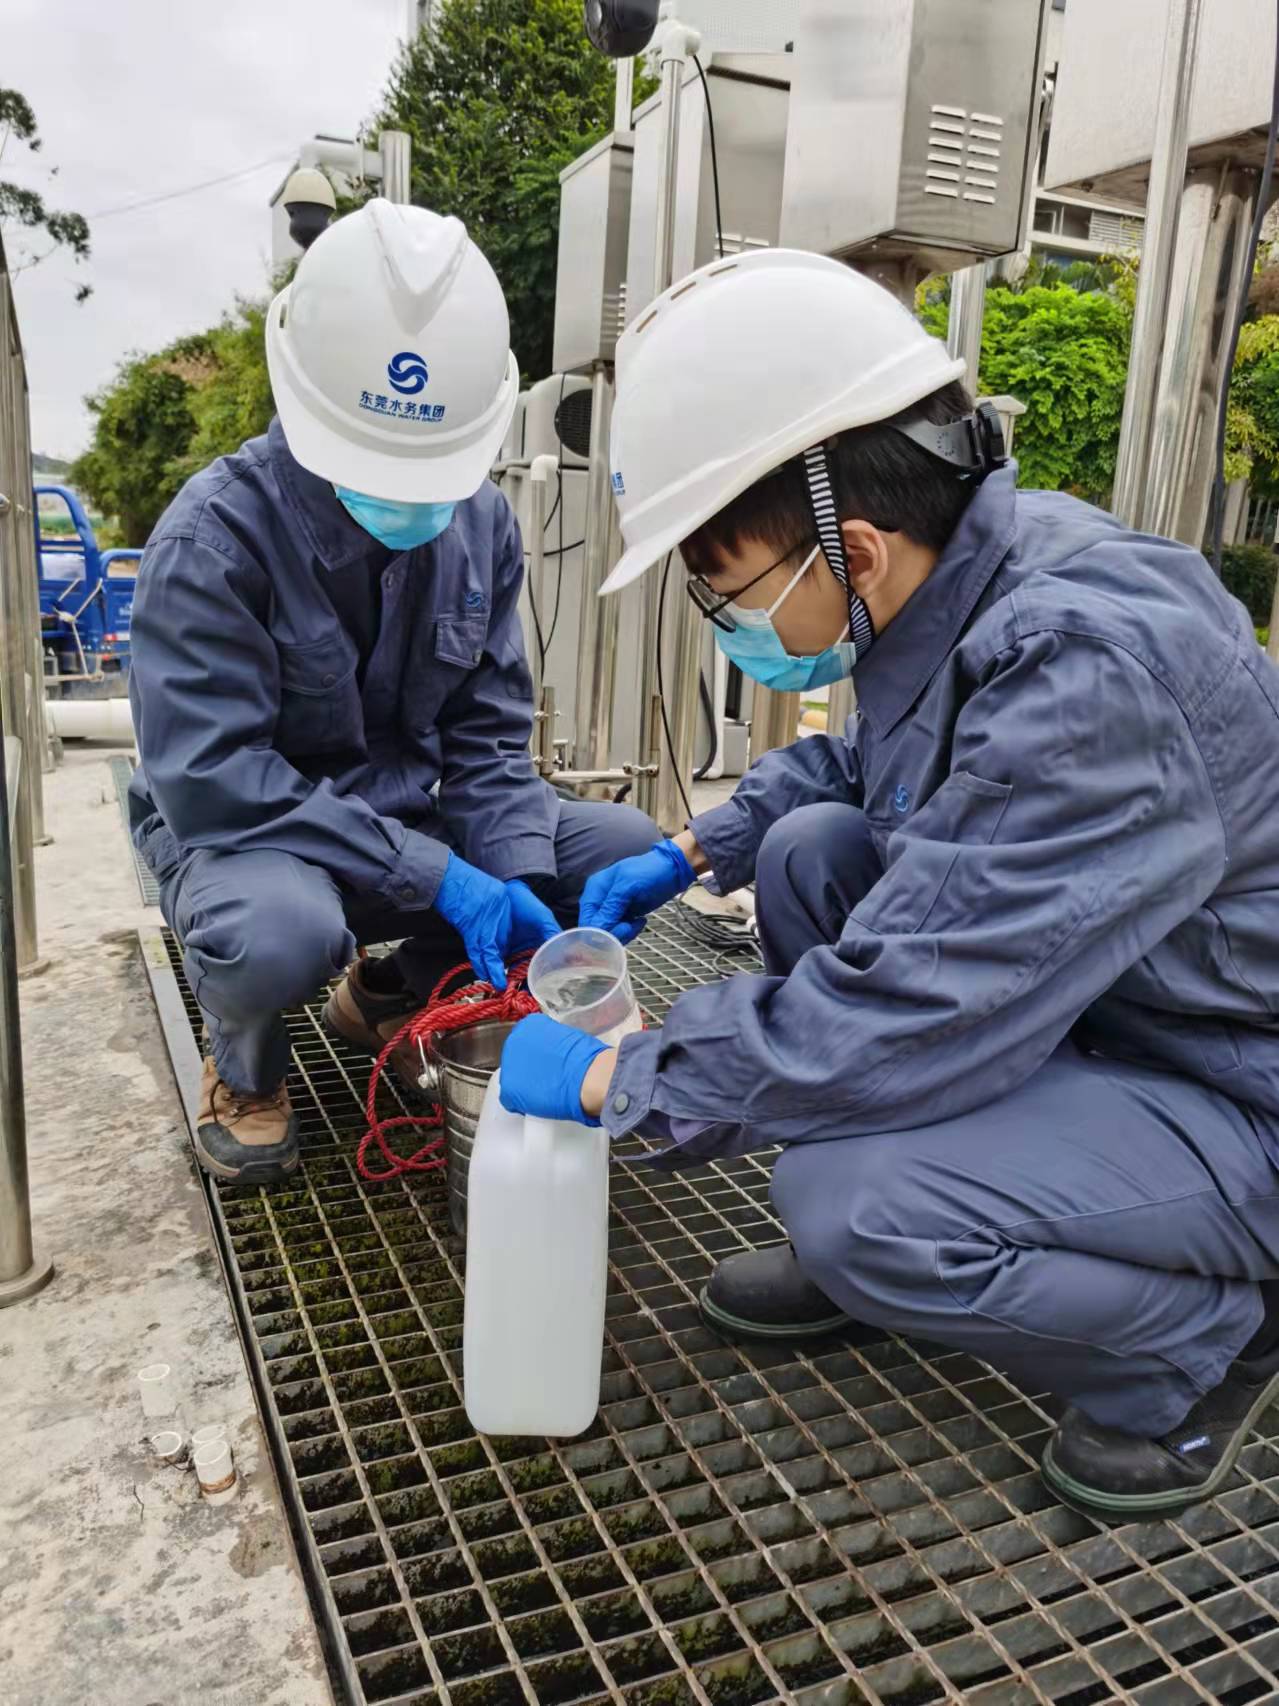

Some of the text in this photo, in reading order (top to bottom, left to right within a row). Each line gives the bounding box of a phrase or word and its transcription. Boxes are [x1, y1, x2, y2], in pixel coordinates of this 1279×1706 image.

[360, 390, 445, 417] 东莞水务集团
